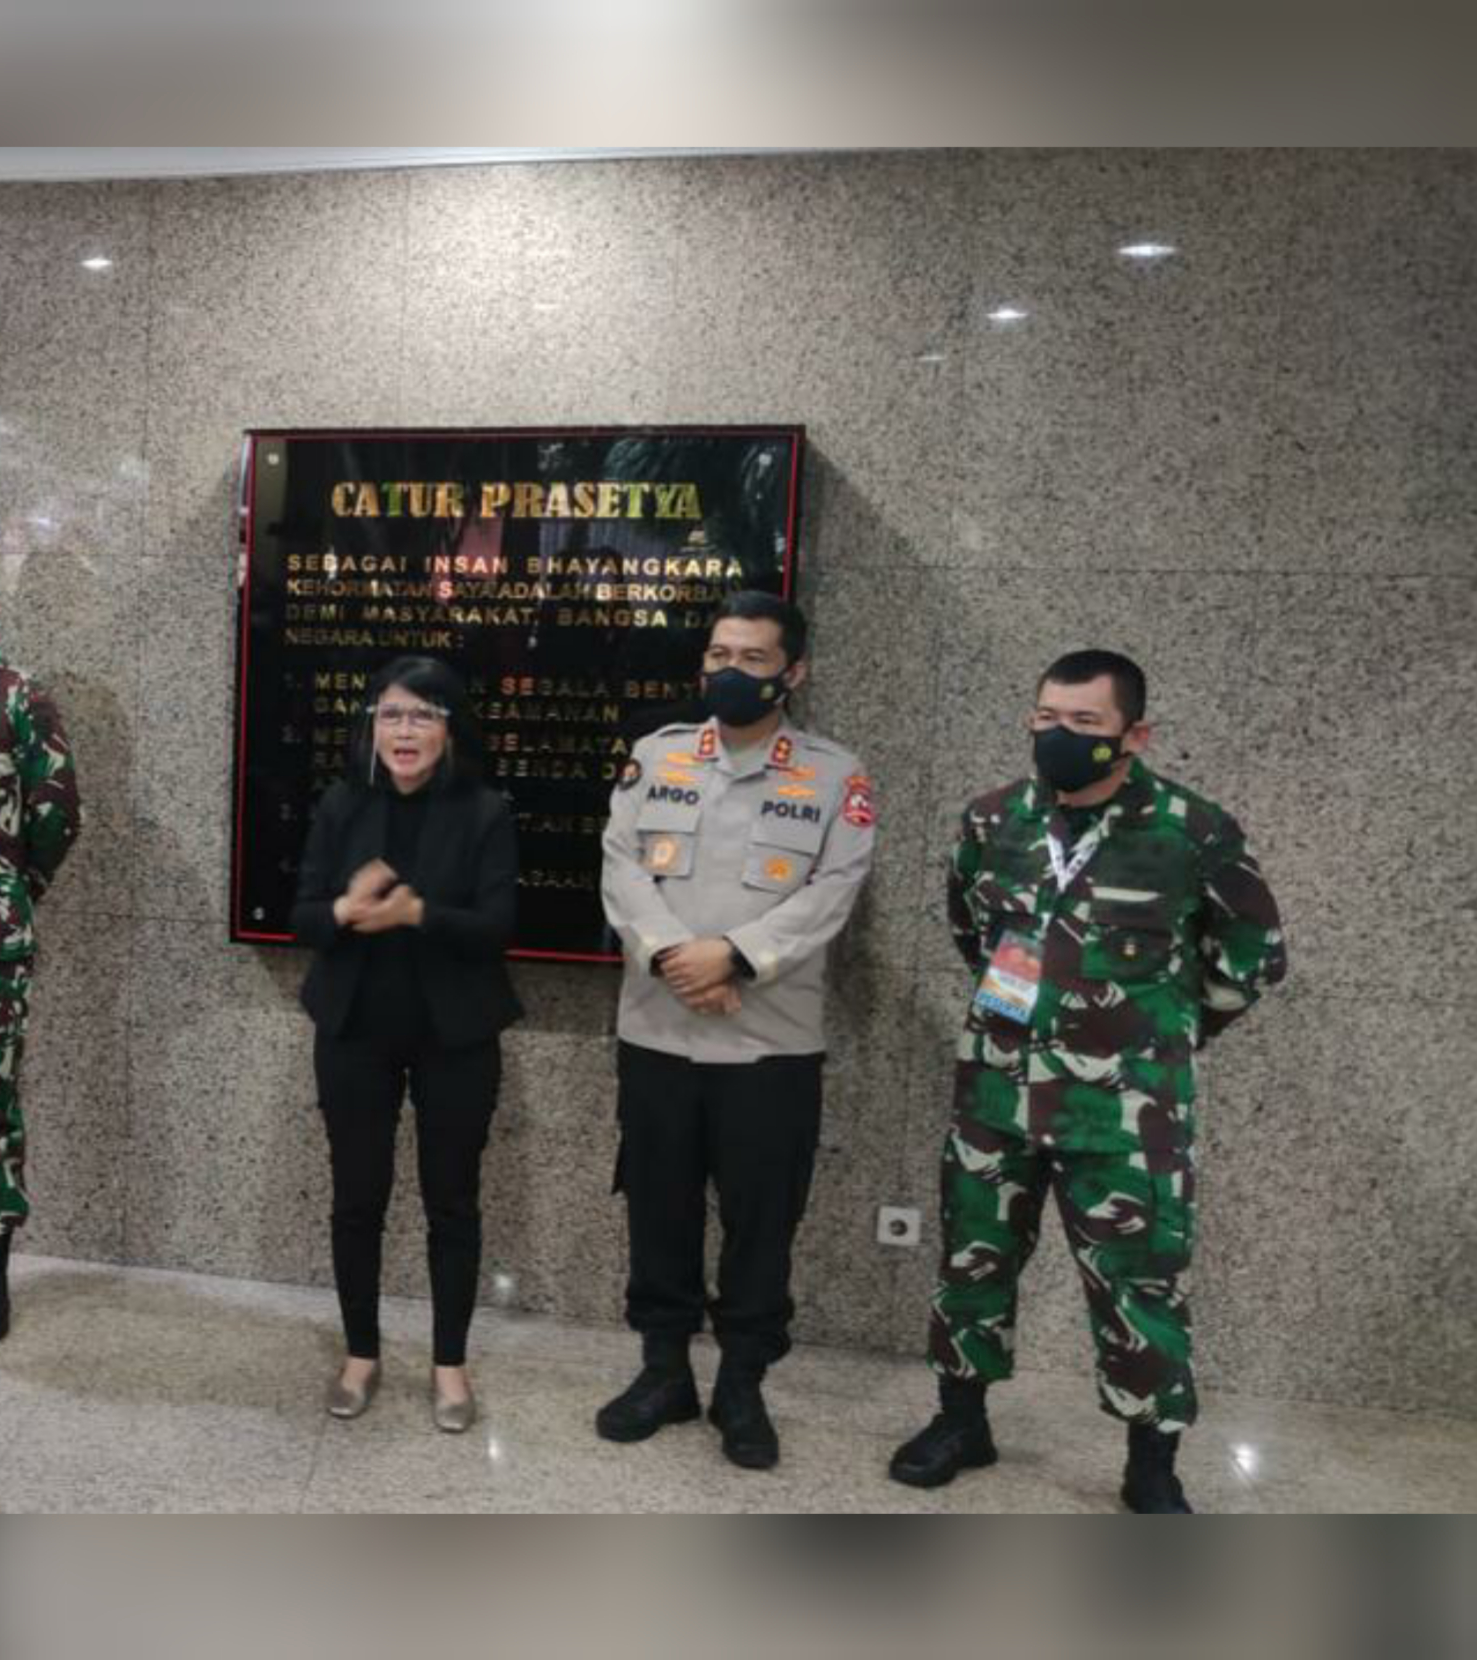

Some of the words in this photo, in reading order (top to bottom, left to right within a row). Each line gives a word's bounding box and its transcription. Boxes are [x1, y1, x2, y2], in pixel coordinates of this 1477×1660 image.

[332, 481, 465, 518] CATUR
[480, 481, 702, 518] PRASETYA
[287, 554, 407, 573] SEBAGAI
[425, 556, 509, 574] INSAN
[527, 557, 743, 578] BHAYANGKARA
[287, 579, 432, 598] KEHORMATAN
[438, 581, 496, 600] SAYA
[498, 582, 590, 600] ADALAH
[596, 583, 723, 604] BERKORBA
[286, 603, 344, 621] DEMI
[557, 608, 668, 628] BANGSA
[285, 629, 375, 647] NEGARA
[379, 631, 451, 648] UNTUK
[500, 676, 610, 697] SEGALA
[646, 784, 701, 806] ARGO
[760, 800, 821, 823] POLRI
